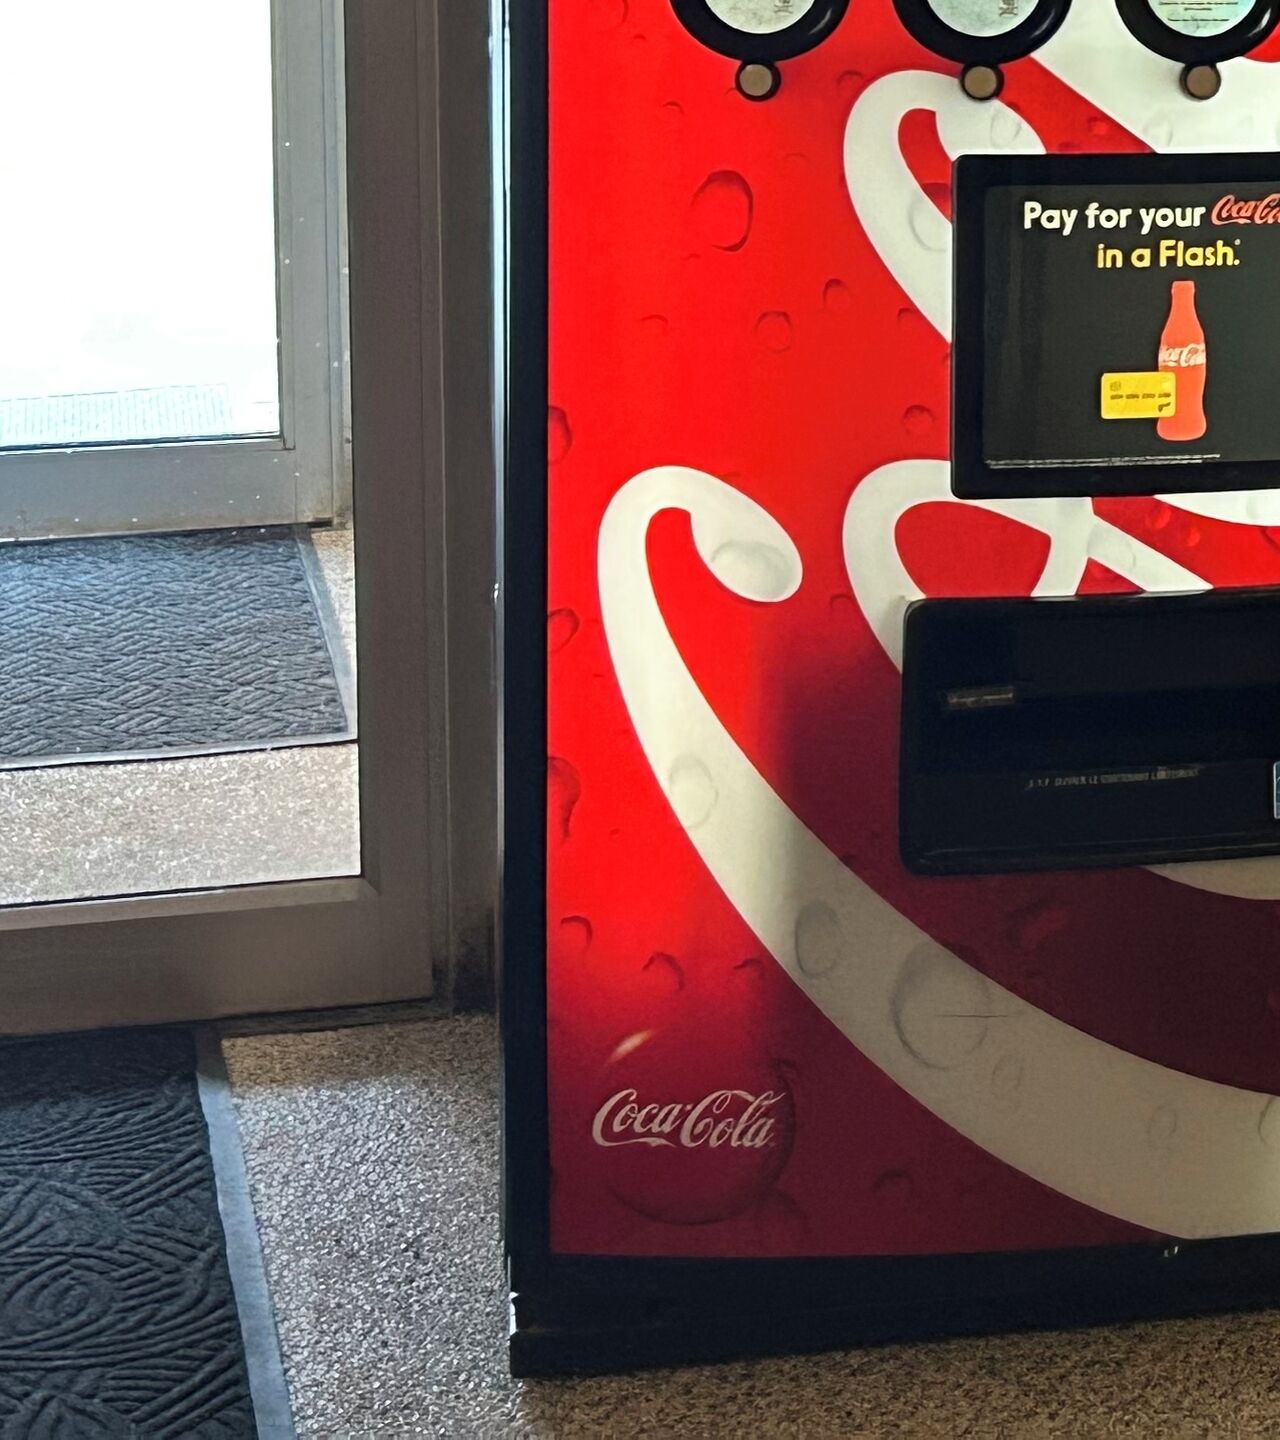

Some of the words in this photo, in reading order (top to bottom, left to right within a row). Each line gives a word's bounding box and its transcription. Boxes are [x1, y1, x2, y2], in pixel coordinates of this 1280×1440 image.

[1023, 201, 1078, 236] Pay
[1084, 202, 1132, 229] for
[1139, 204, 1207, 235] your
[1097, 243, 1123, 269] in
[1130, 246, 1151, 267] a
[592, 1088, 786, 1148] Coca-Cola
